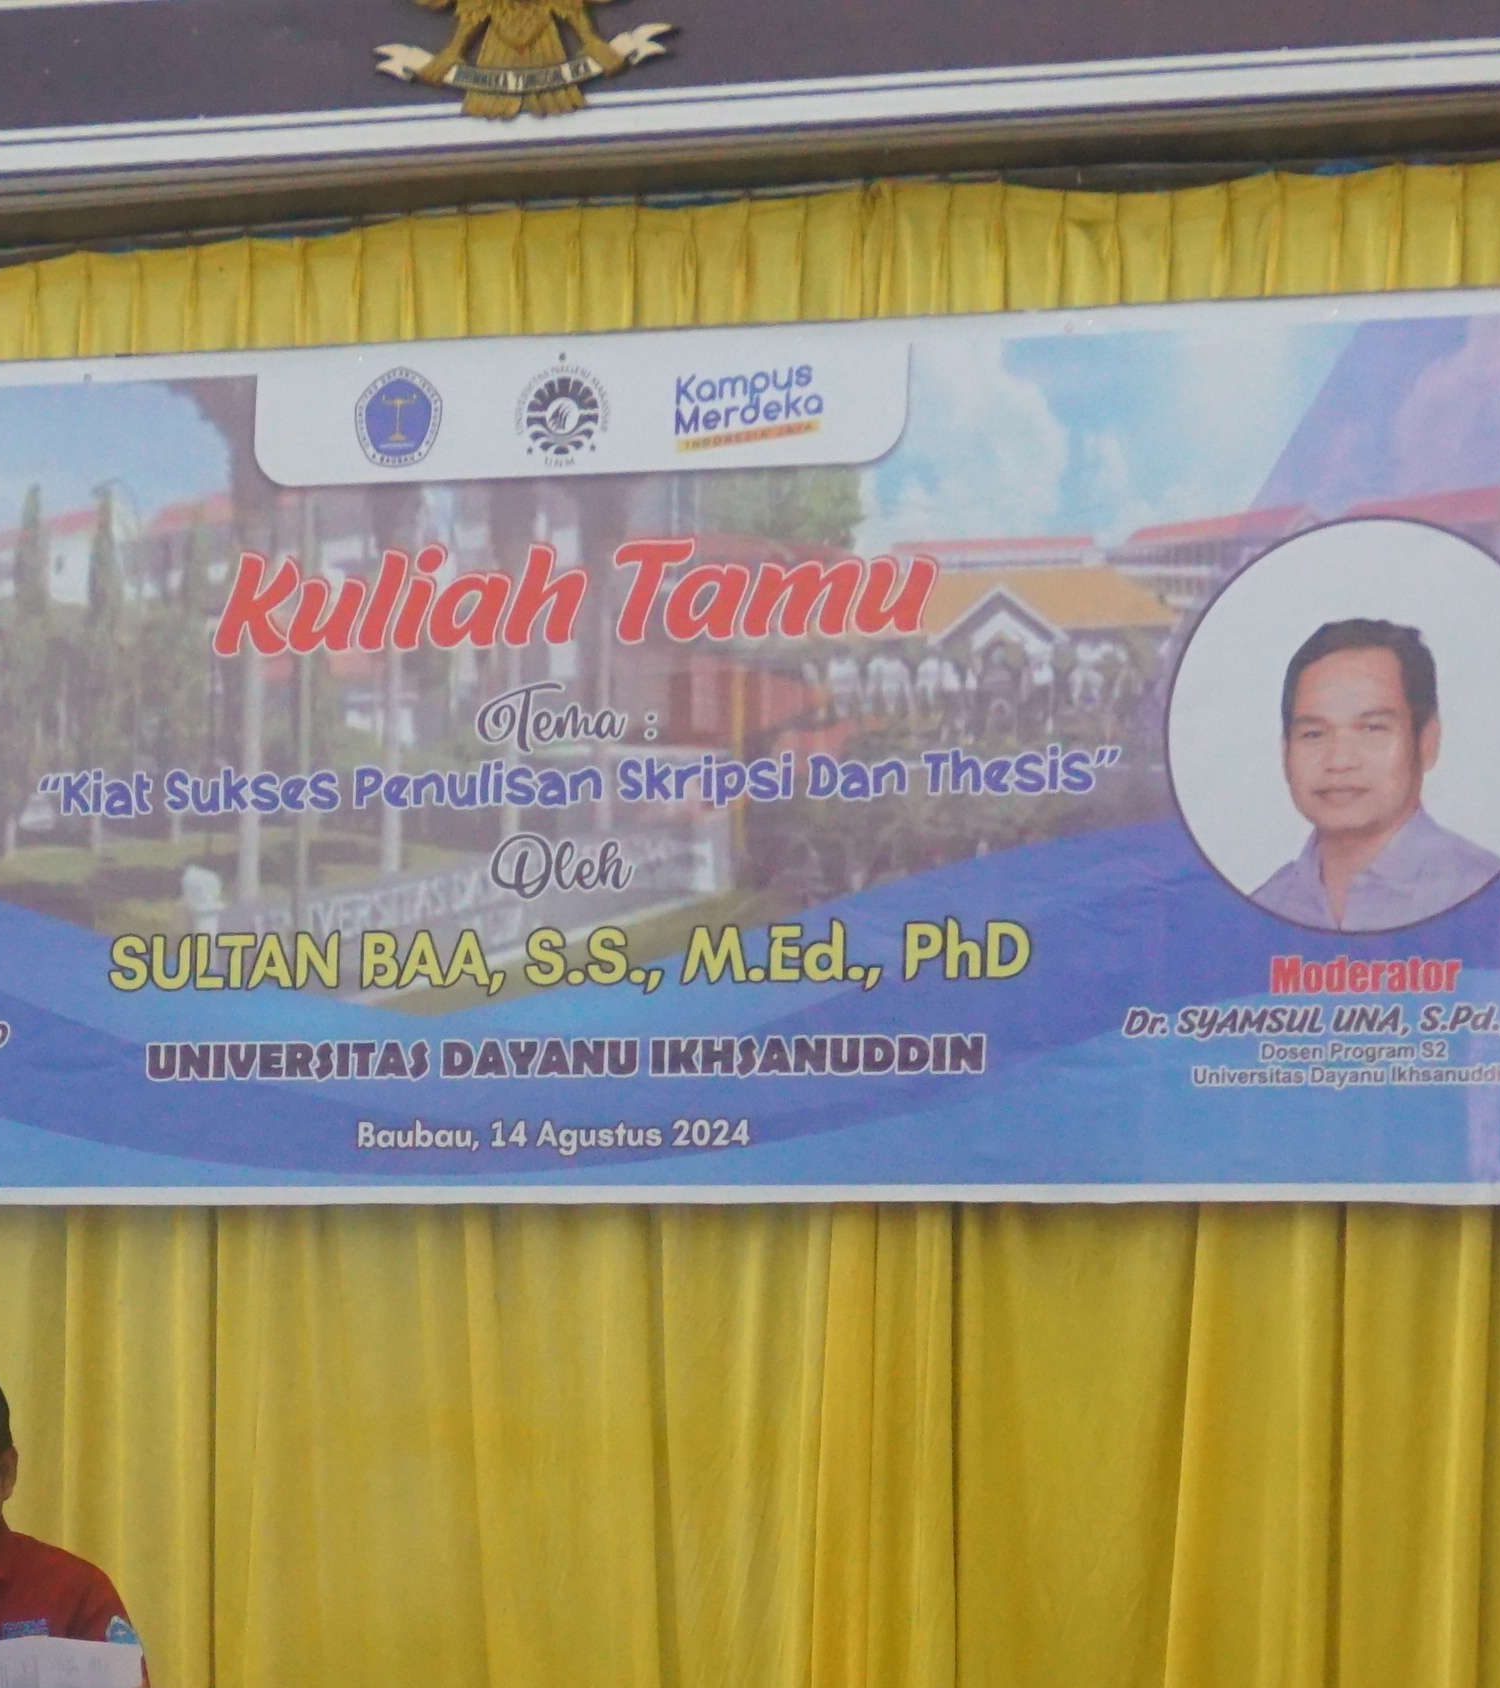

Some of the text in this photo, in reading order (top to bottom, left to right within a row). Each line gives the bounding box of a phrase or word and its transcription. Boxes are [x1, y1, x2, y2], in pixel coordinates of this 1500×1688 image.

[675, 364, 813, 406] Kampus
[674, 390, 824, 435] Merdeka
[543, 455, 576, 469] UNM
[213, 538, 938, 657] Kuliah Tamu
[476, 682, 628, 754] Tema
[164, 766, 341, 816] Sukses
[352, 760, 603, 809] Penulisan
[617, 750, 795, 808] Skripsi
[806, 752, 907, 801] Dan
[488, 832, 636, 900] Oleh
[109, 930, 340, 991] SULTAN
[360, 927, 506, 996] BAA,
[523, 925, 666, 995] S.S.,
[680, 917, 883, 991] M.Ed.,
[902, 914, 1031, 982] PhD
[1270, 954, 1462, 994] Moderator
[1122, 1005, 1169, 1037] Dr.
[1175, 1004, 1325, 1041] SYAMSUL
[1331, 1003, 1411, 1036] UNA,
[145, 1033, 987, 1083] UNIVERSITAS DAYANU IKHSANUDDIN
[1259, 1039, 1448, 1063] Dosen Program S2
[1191, 1065, 1304, 1087] Universitas
[1308, 1065, 1386, 1091] Dayanu
[357, 1118, 750, 1156] Baubau, 14 Agustus 2024
